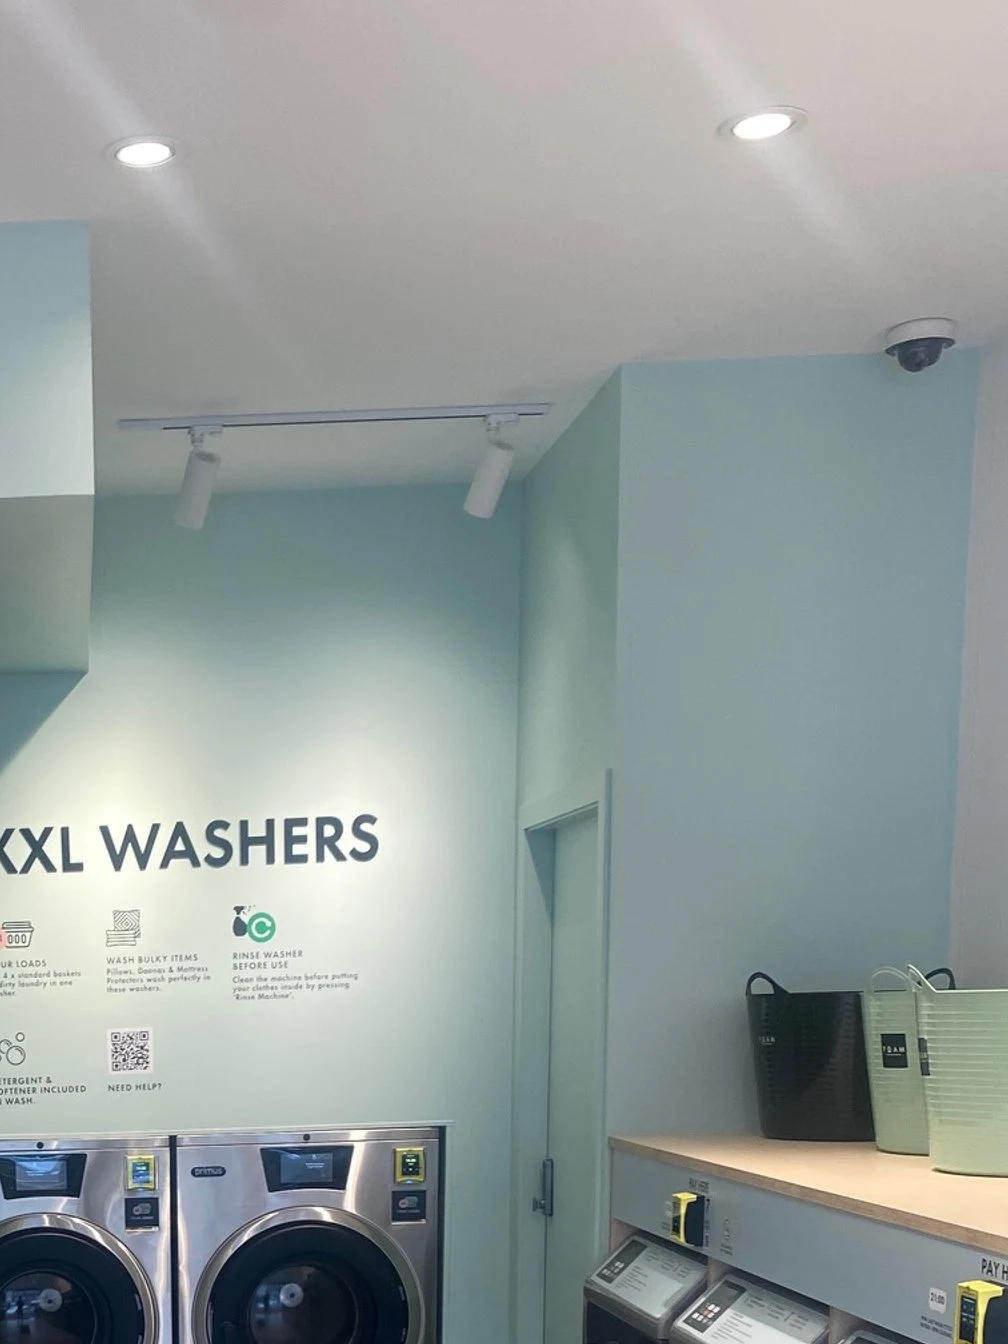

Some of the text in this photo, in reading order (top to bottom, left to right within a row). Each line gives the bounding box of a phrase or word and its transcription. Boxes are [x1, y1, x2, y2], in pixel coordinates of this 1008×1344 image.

[99, 813, 380, 872] WASHERS
[106, 953, 198, 964] WASH BULKY ITEMS
[232, 949, 303, 960] RINSE WASHER
[16, 959, 47, 968] LOADS
[232, 960, 288, 970] BEFORE USE
[18, 970, 51, 979] standard
[53, 970, 82, 978] baskets
[146, 975, 166, 983] wash
[232, 972, 358, 984] Clean the machine before putting
[45, 1076, 52, 1084] &
[41, 1085, 87, 1094] INCLUDED
[107, 1082, 162, 1092] NEED HELP?
[981, 1258, 1001, 1278] PAY
